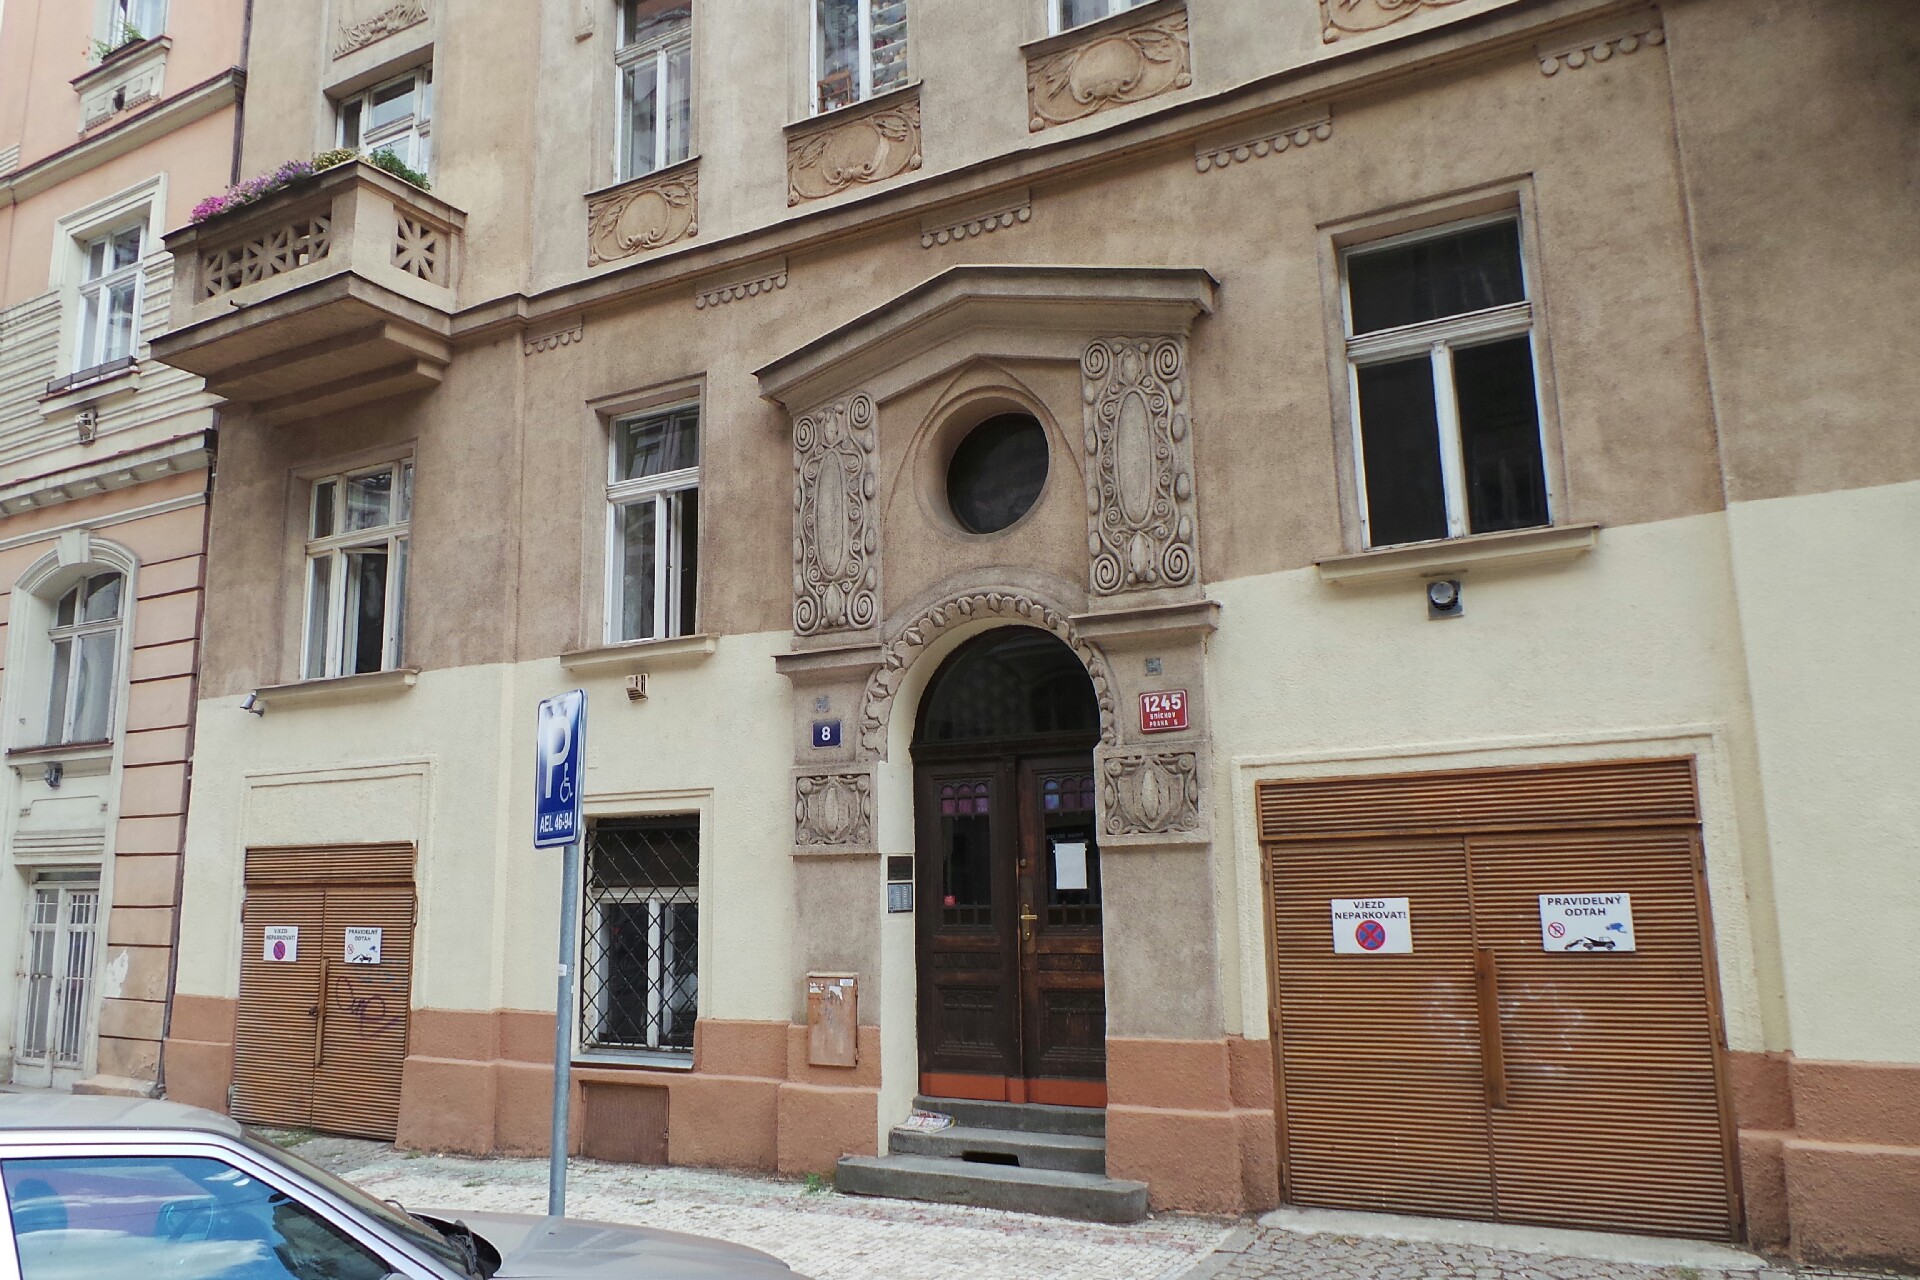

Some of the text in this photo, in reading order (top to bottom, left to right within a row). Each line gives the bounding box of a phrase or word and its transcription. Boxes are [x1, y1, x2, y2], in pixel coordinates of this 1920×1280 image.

[1144, 694, 1181, 713] 1245
[821, 726, 831, 741] 8
[545, 715, 572, 799] P
[540, 812, 573, 833] AEL 46-94
[1353, 901, 1385, 909] VJEZD
[1547, 895, 1622, 905] PRAVIDELNÝ
[1335, 911, 1407, 920] NEPARKOVAT!
[1564, 908, 1606, 916] ODTAH
